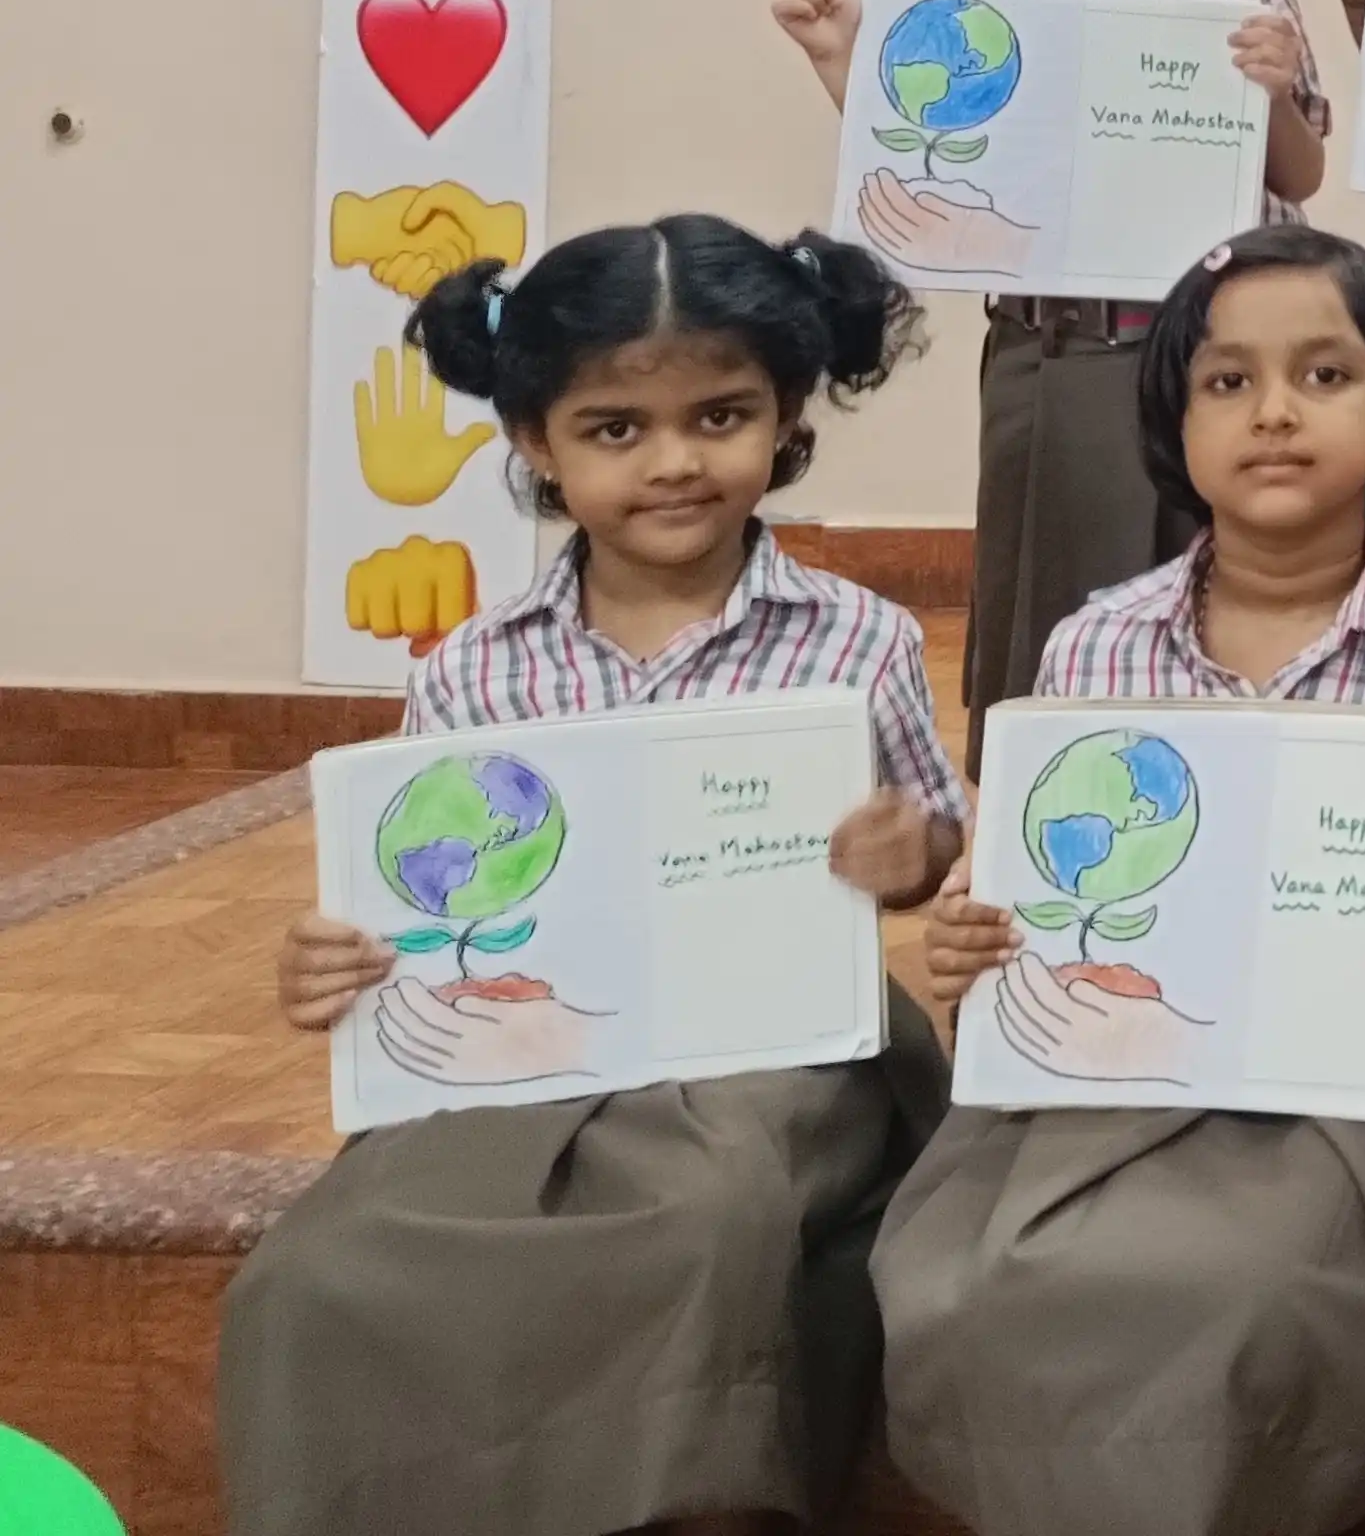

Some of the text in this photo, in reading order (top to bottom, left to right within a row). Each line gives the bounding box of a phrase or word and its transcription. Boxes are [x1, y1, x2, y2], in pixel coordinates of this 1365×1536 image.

[1141, 52, 1200, 82] Happy
[1091, 106, 1256, 132] Vana Mahostava
[702, 771, 771, 796] Happy
[1270, 871, 1326, 895] Vana
